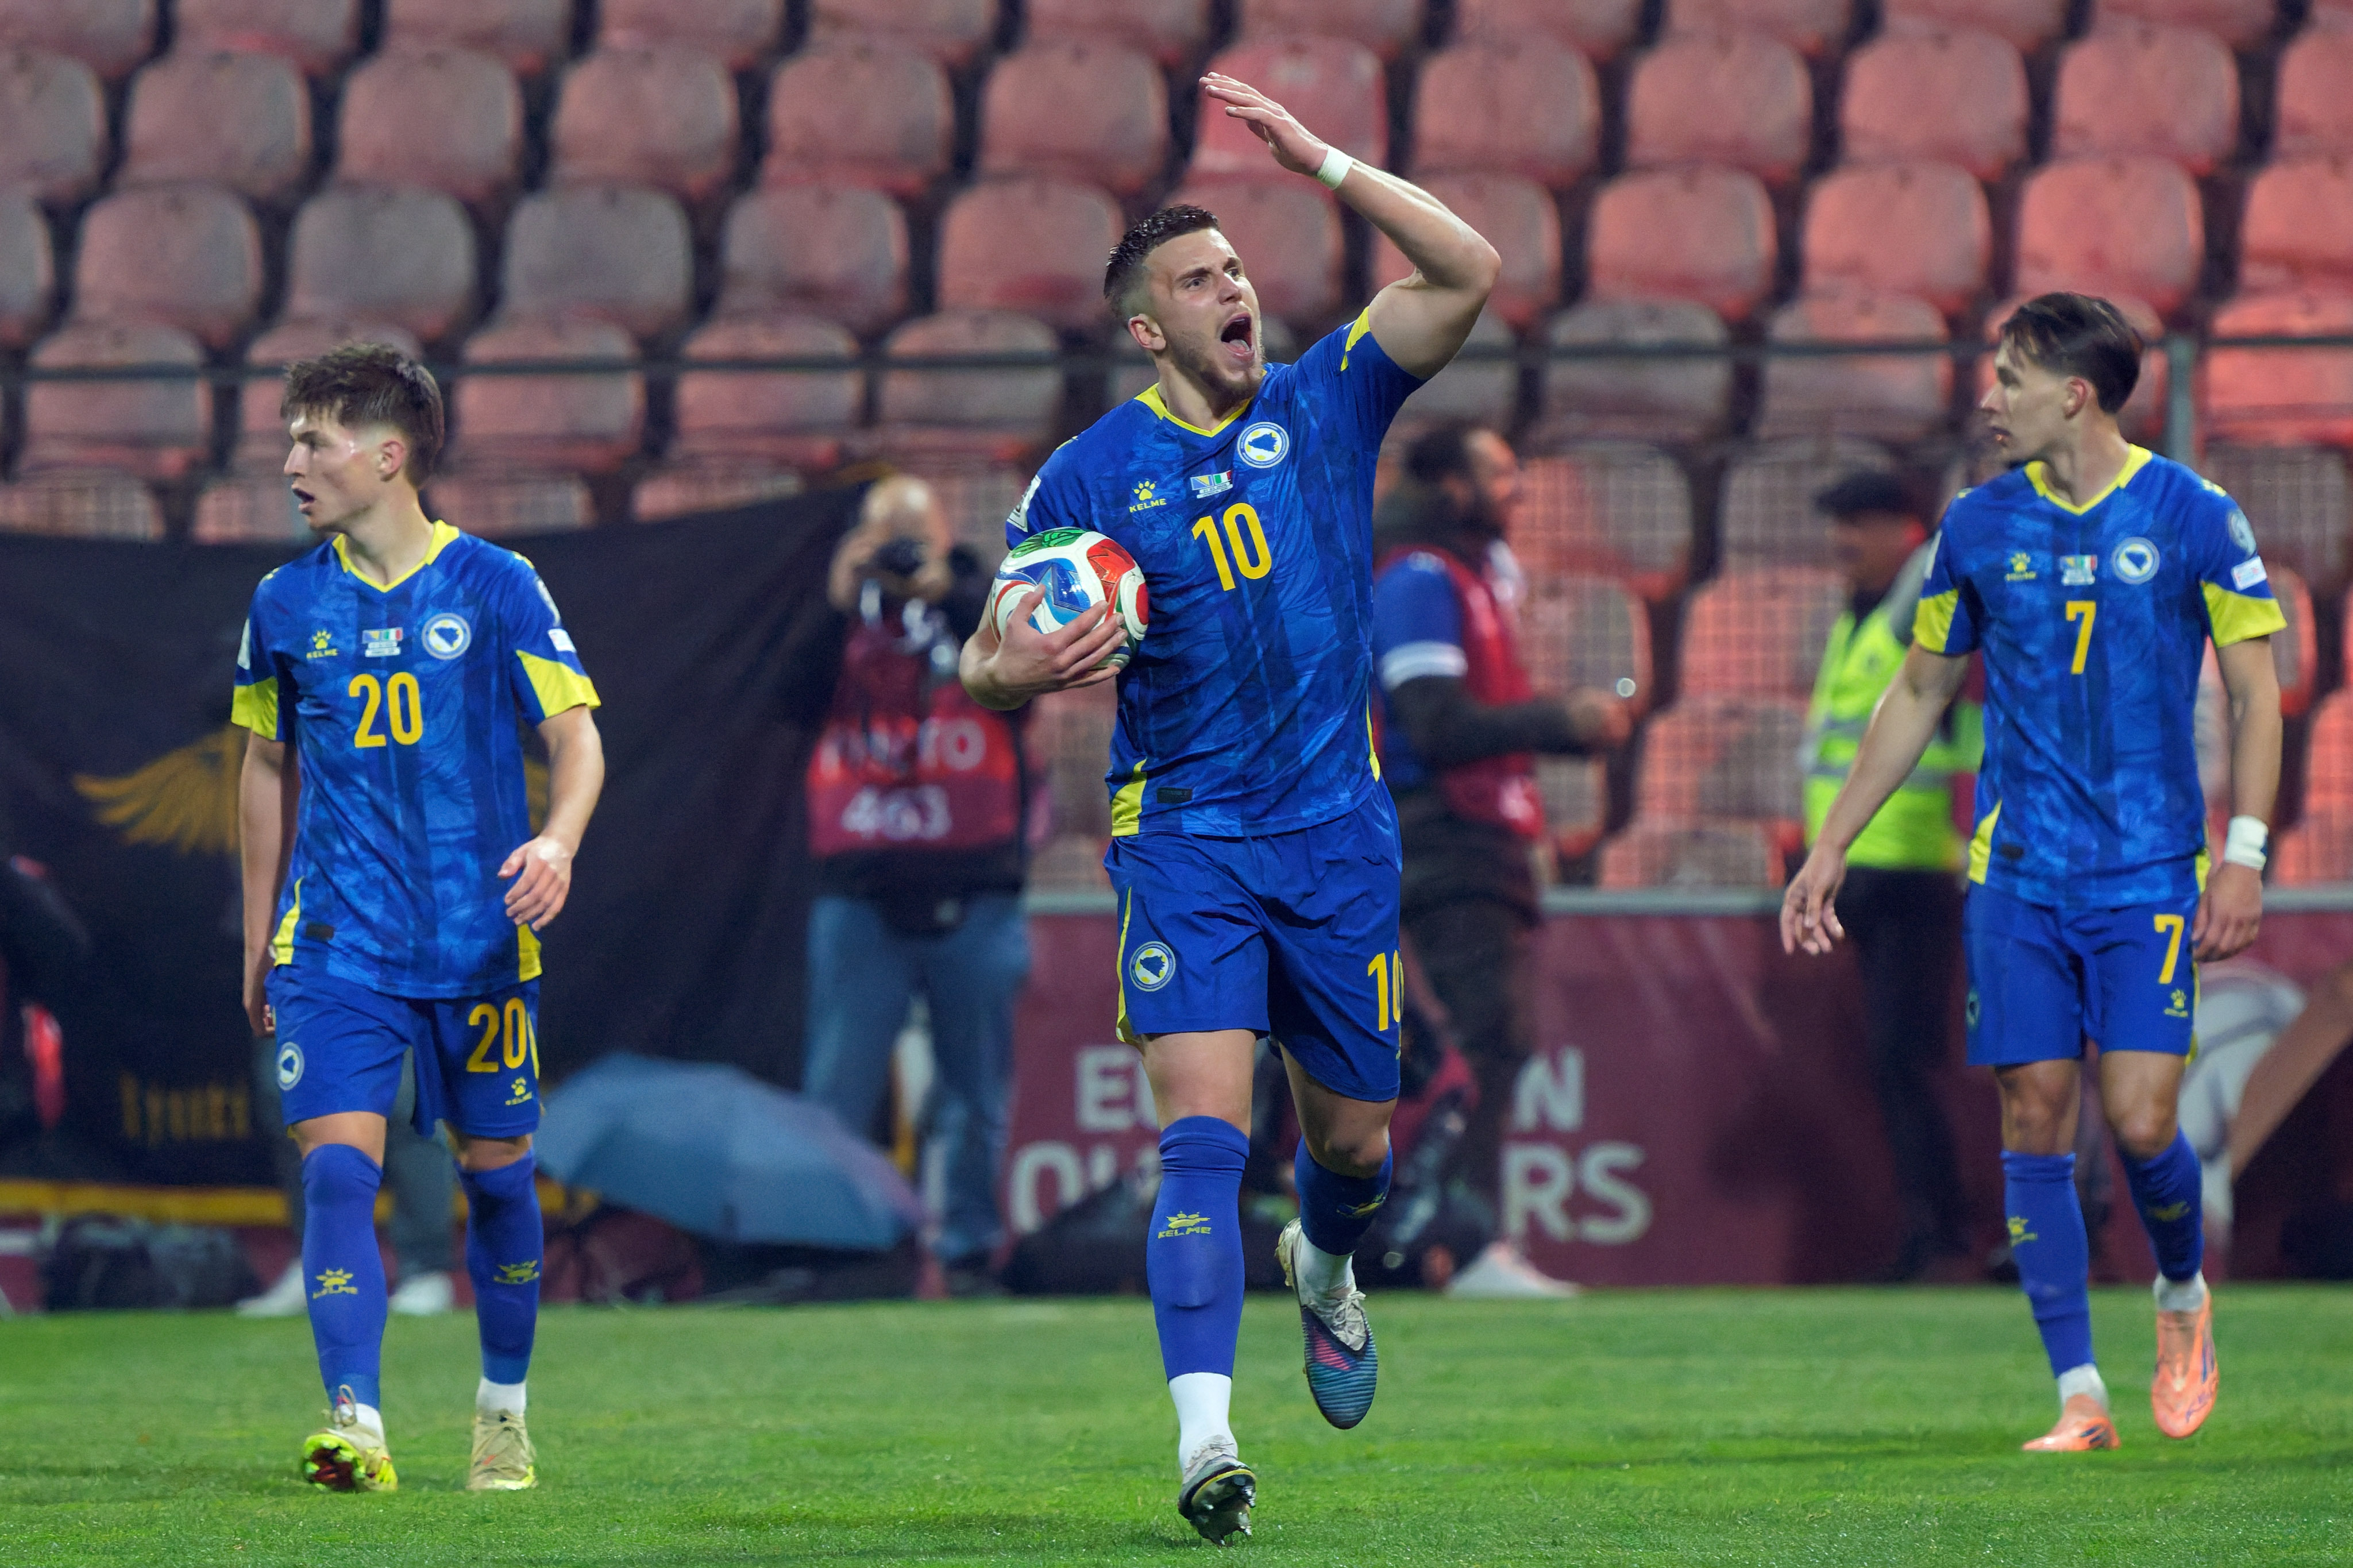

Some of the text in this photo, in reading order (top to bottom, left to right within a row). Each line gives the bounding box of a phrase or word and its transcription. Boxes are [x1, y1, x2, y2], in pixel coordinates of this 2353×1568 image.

[1129, 498, 1167, 513] KELME
[1191, 503, 1272, 592] 10
[2066, 601, 2096, 674] 7
[348, 671, 423, 748] 20
[2154, 914, 2184, 984] 7
[466, 997, 527, 1073] 20
[1158, 1226, 1212, 1239] KELME
